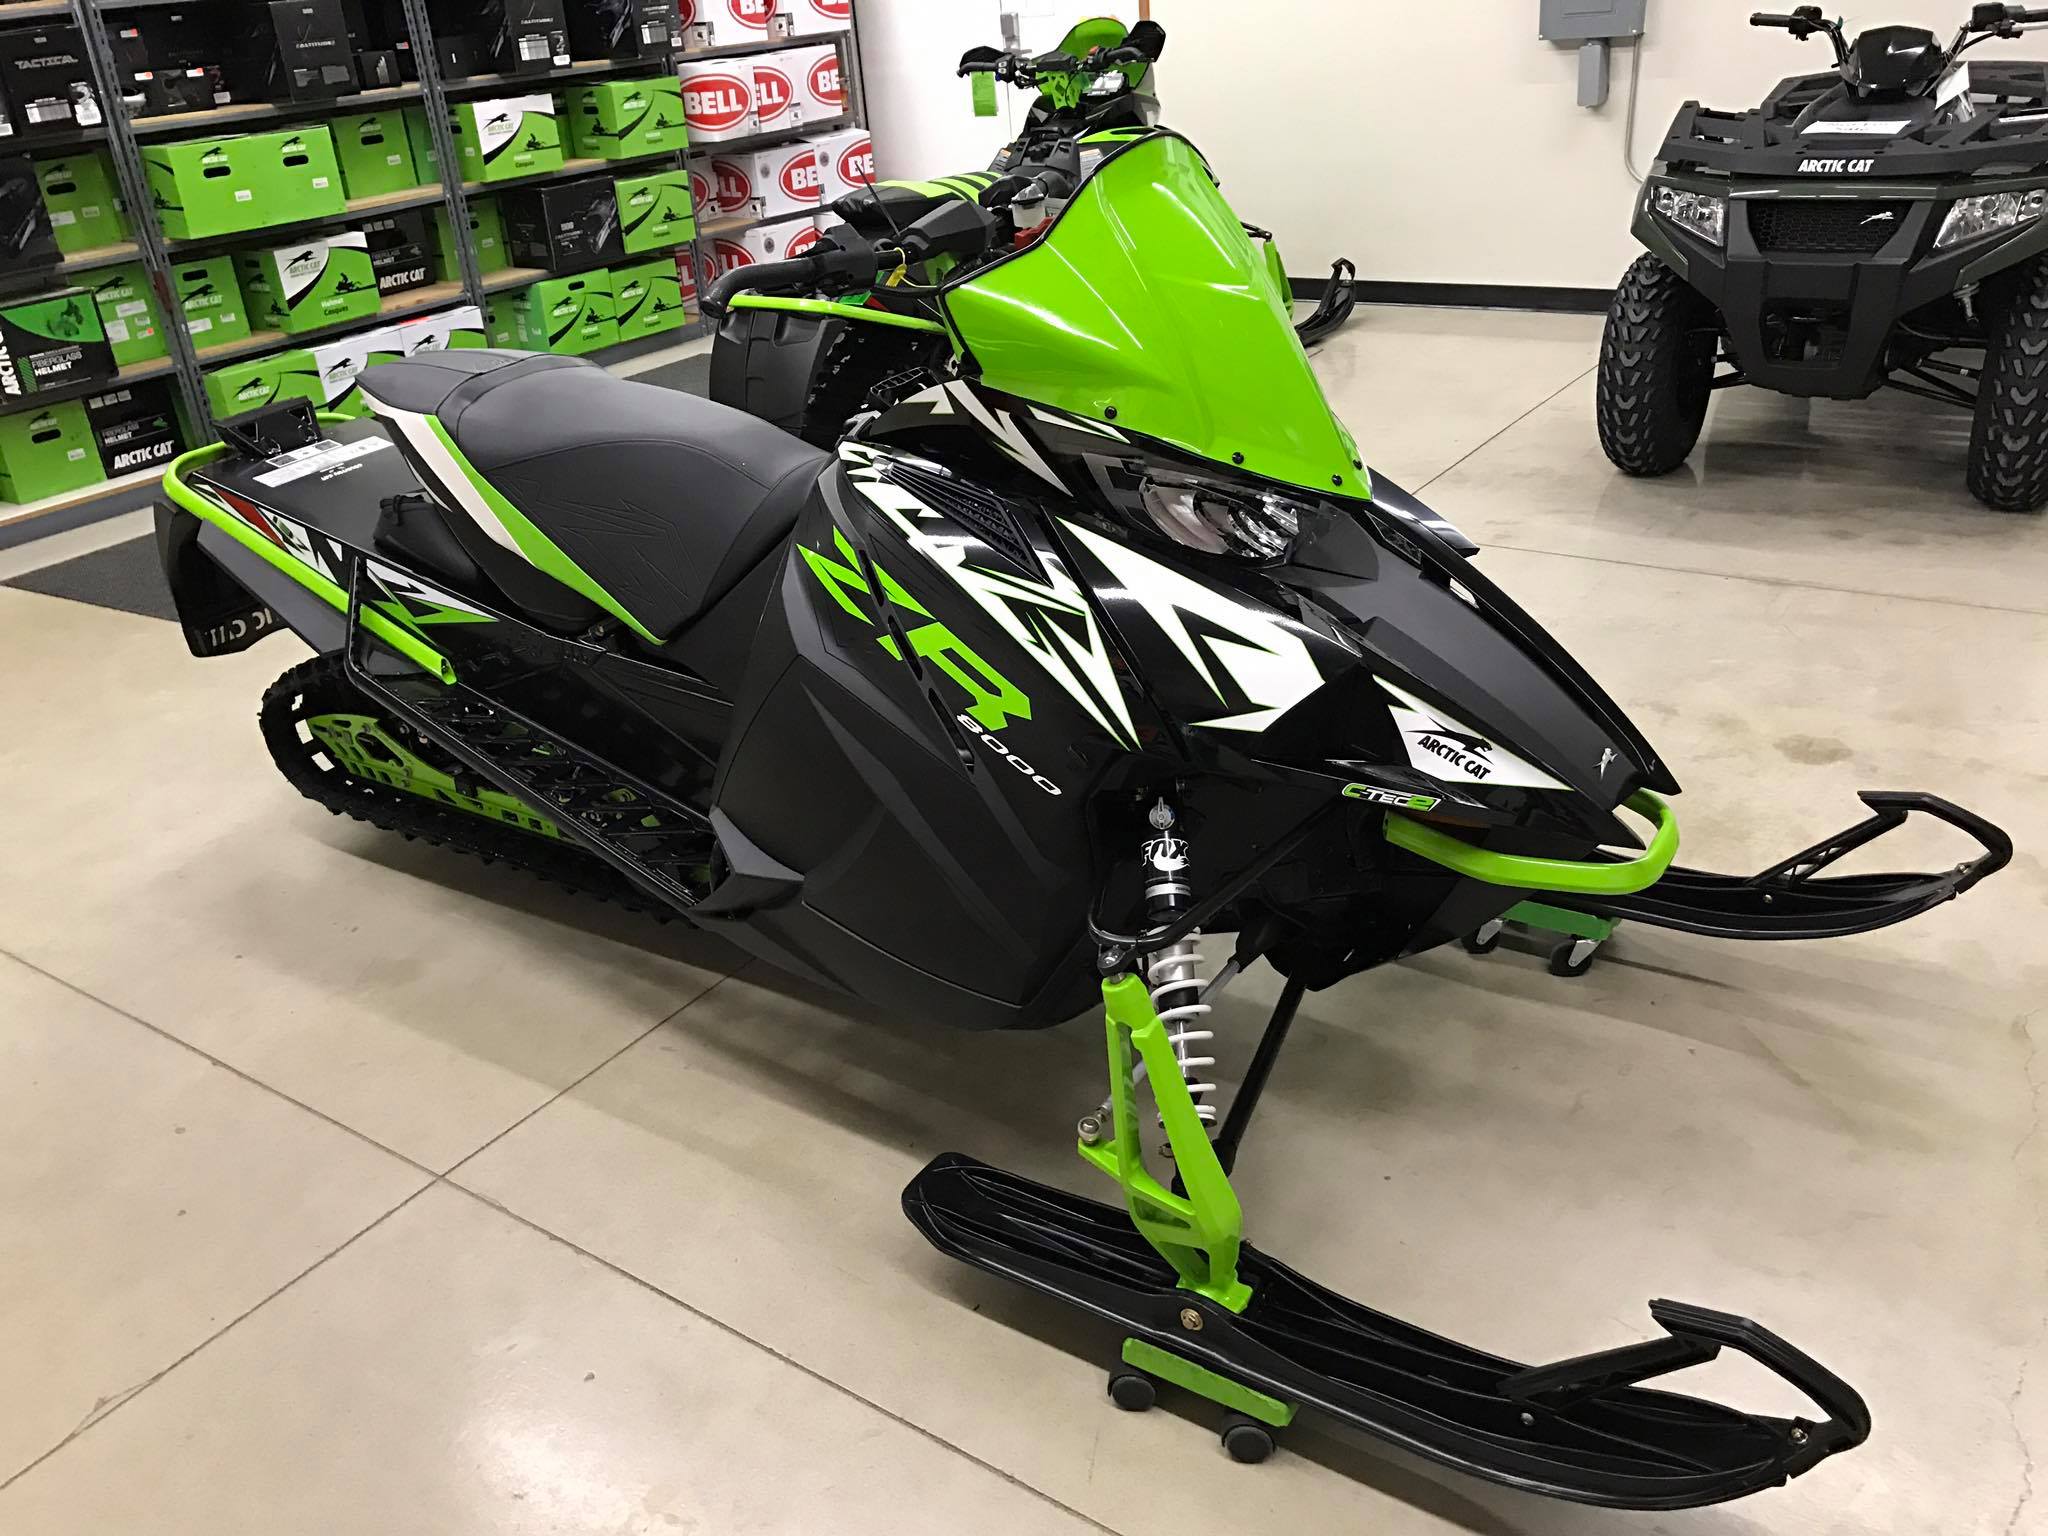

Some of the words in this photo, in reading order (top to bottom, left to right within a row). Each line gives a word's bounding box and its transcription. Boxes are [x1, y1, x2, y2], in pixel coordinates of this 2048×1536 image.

[14, 55, 79, 69] TACTICAL
[683, 89, 743, 115] BELL
[1797, 159, 1846, 173] ARCTIC
[1847, 159, 1875, 173] CAT
[380, 271, 409, 289] ARCTIC
[409, 267, 426, 281] CAT
[32, 351, 82, 369] FIBERGLASS
[34, 361, 72, 376] HELMET
[114, 446, 153, 469] ARCTIC
[153, 440, 175, 457] CAT
[956, 714, 1062, 796] 8000
[1417, 735, 1466, 767] ARCTIC
[1463, 760, 1491, 780] CAT
[1141, 838, 1191, 868] FOX
